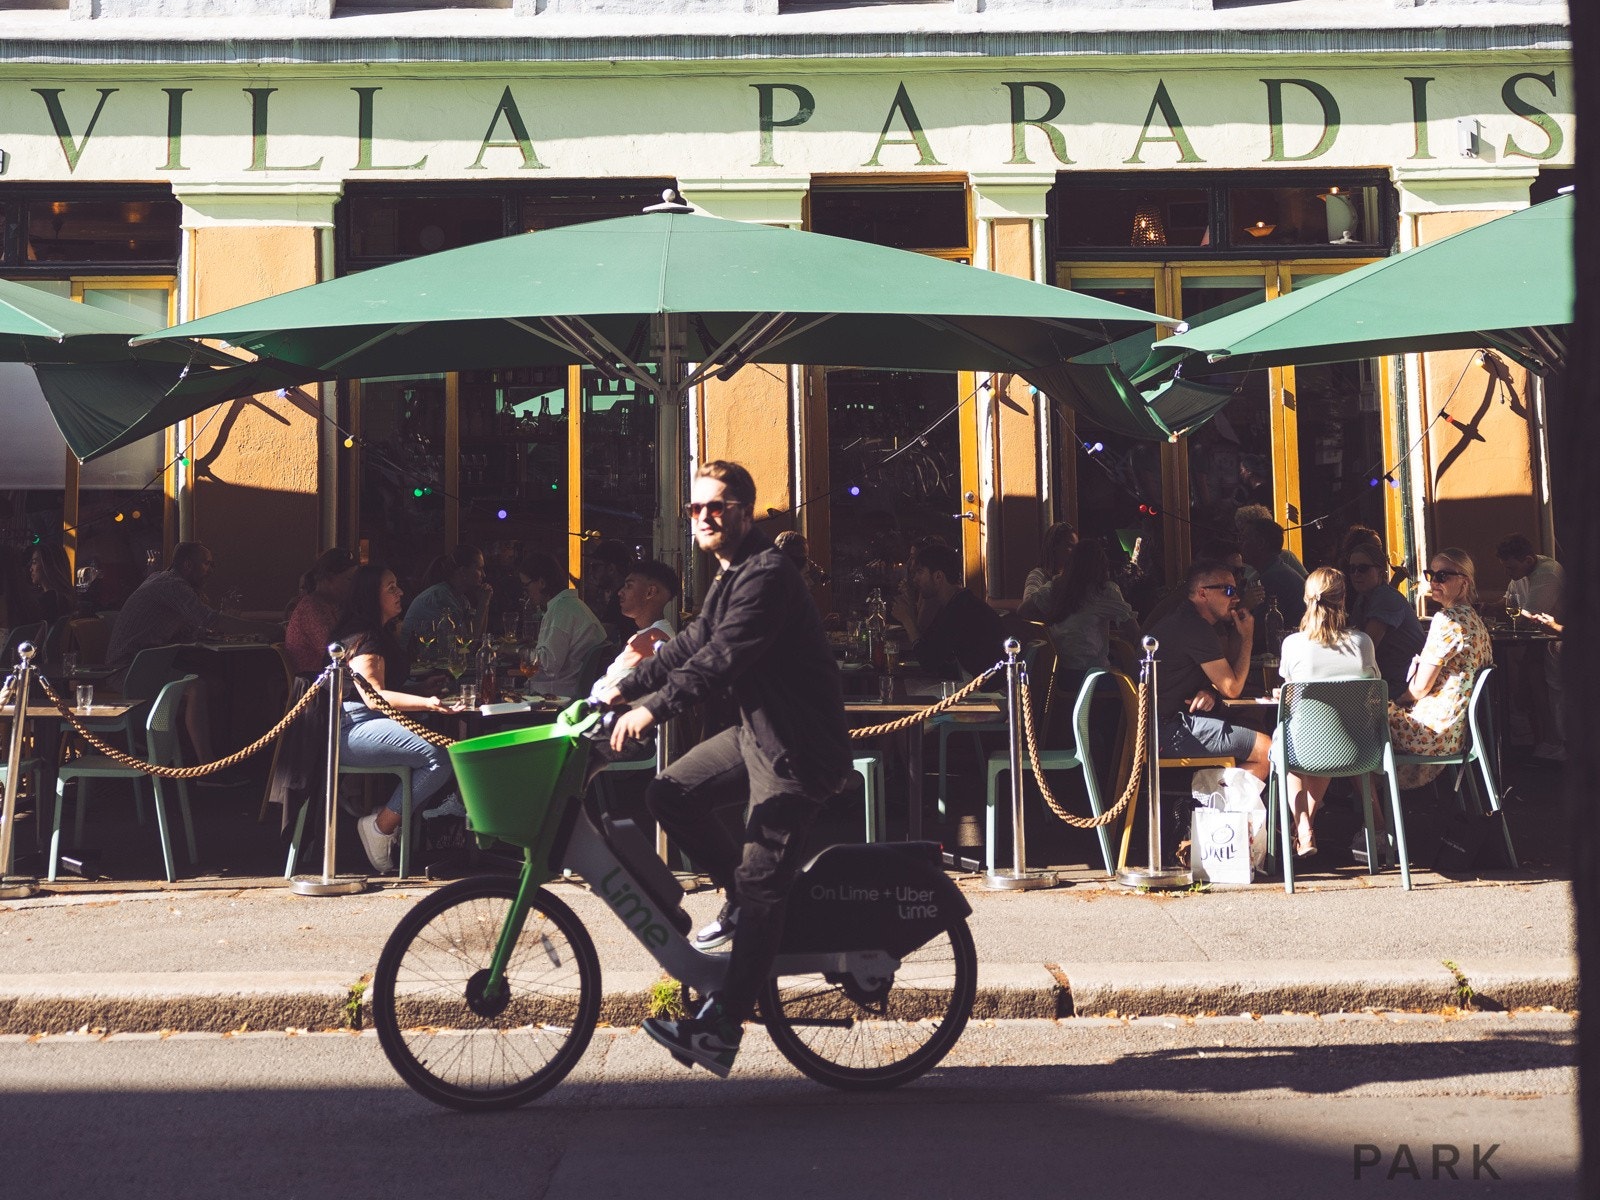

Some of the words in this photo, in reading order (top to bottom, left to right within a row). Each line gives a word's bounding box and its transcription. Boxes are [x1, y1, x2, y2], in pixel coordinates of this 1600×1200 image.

[31, 85, 550, 174] VILLA
[749, 70, 1566, 168] PARADIS
[600, 867, 669, 949] Lime
[811, 885, 836, 900] On
[840, 884, 879, 901] Lime
[895, 886, 935, 902] Uber
